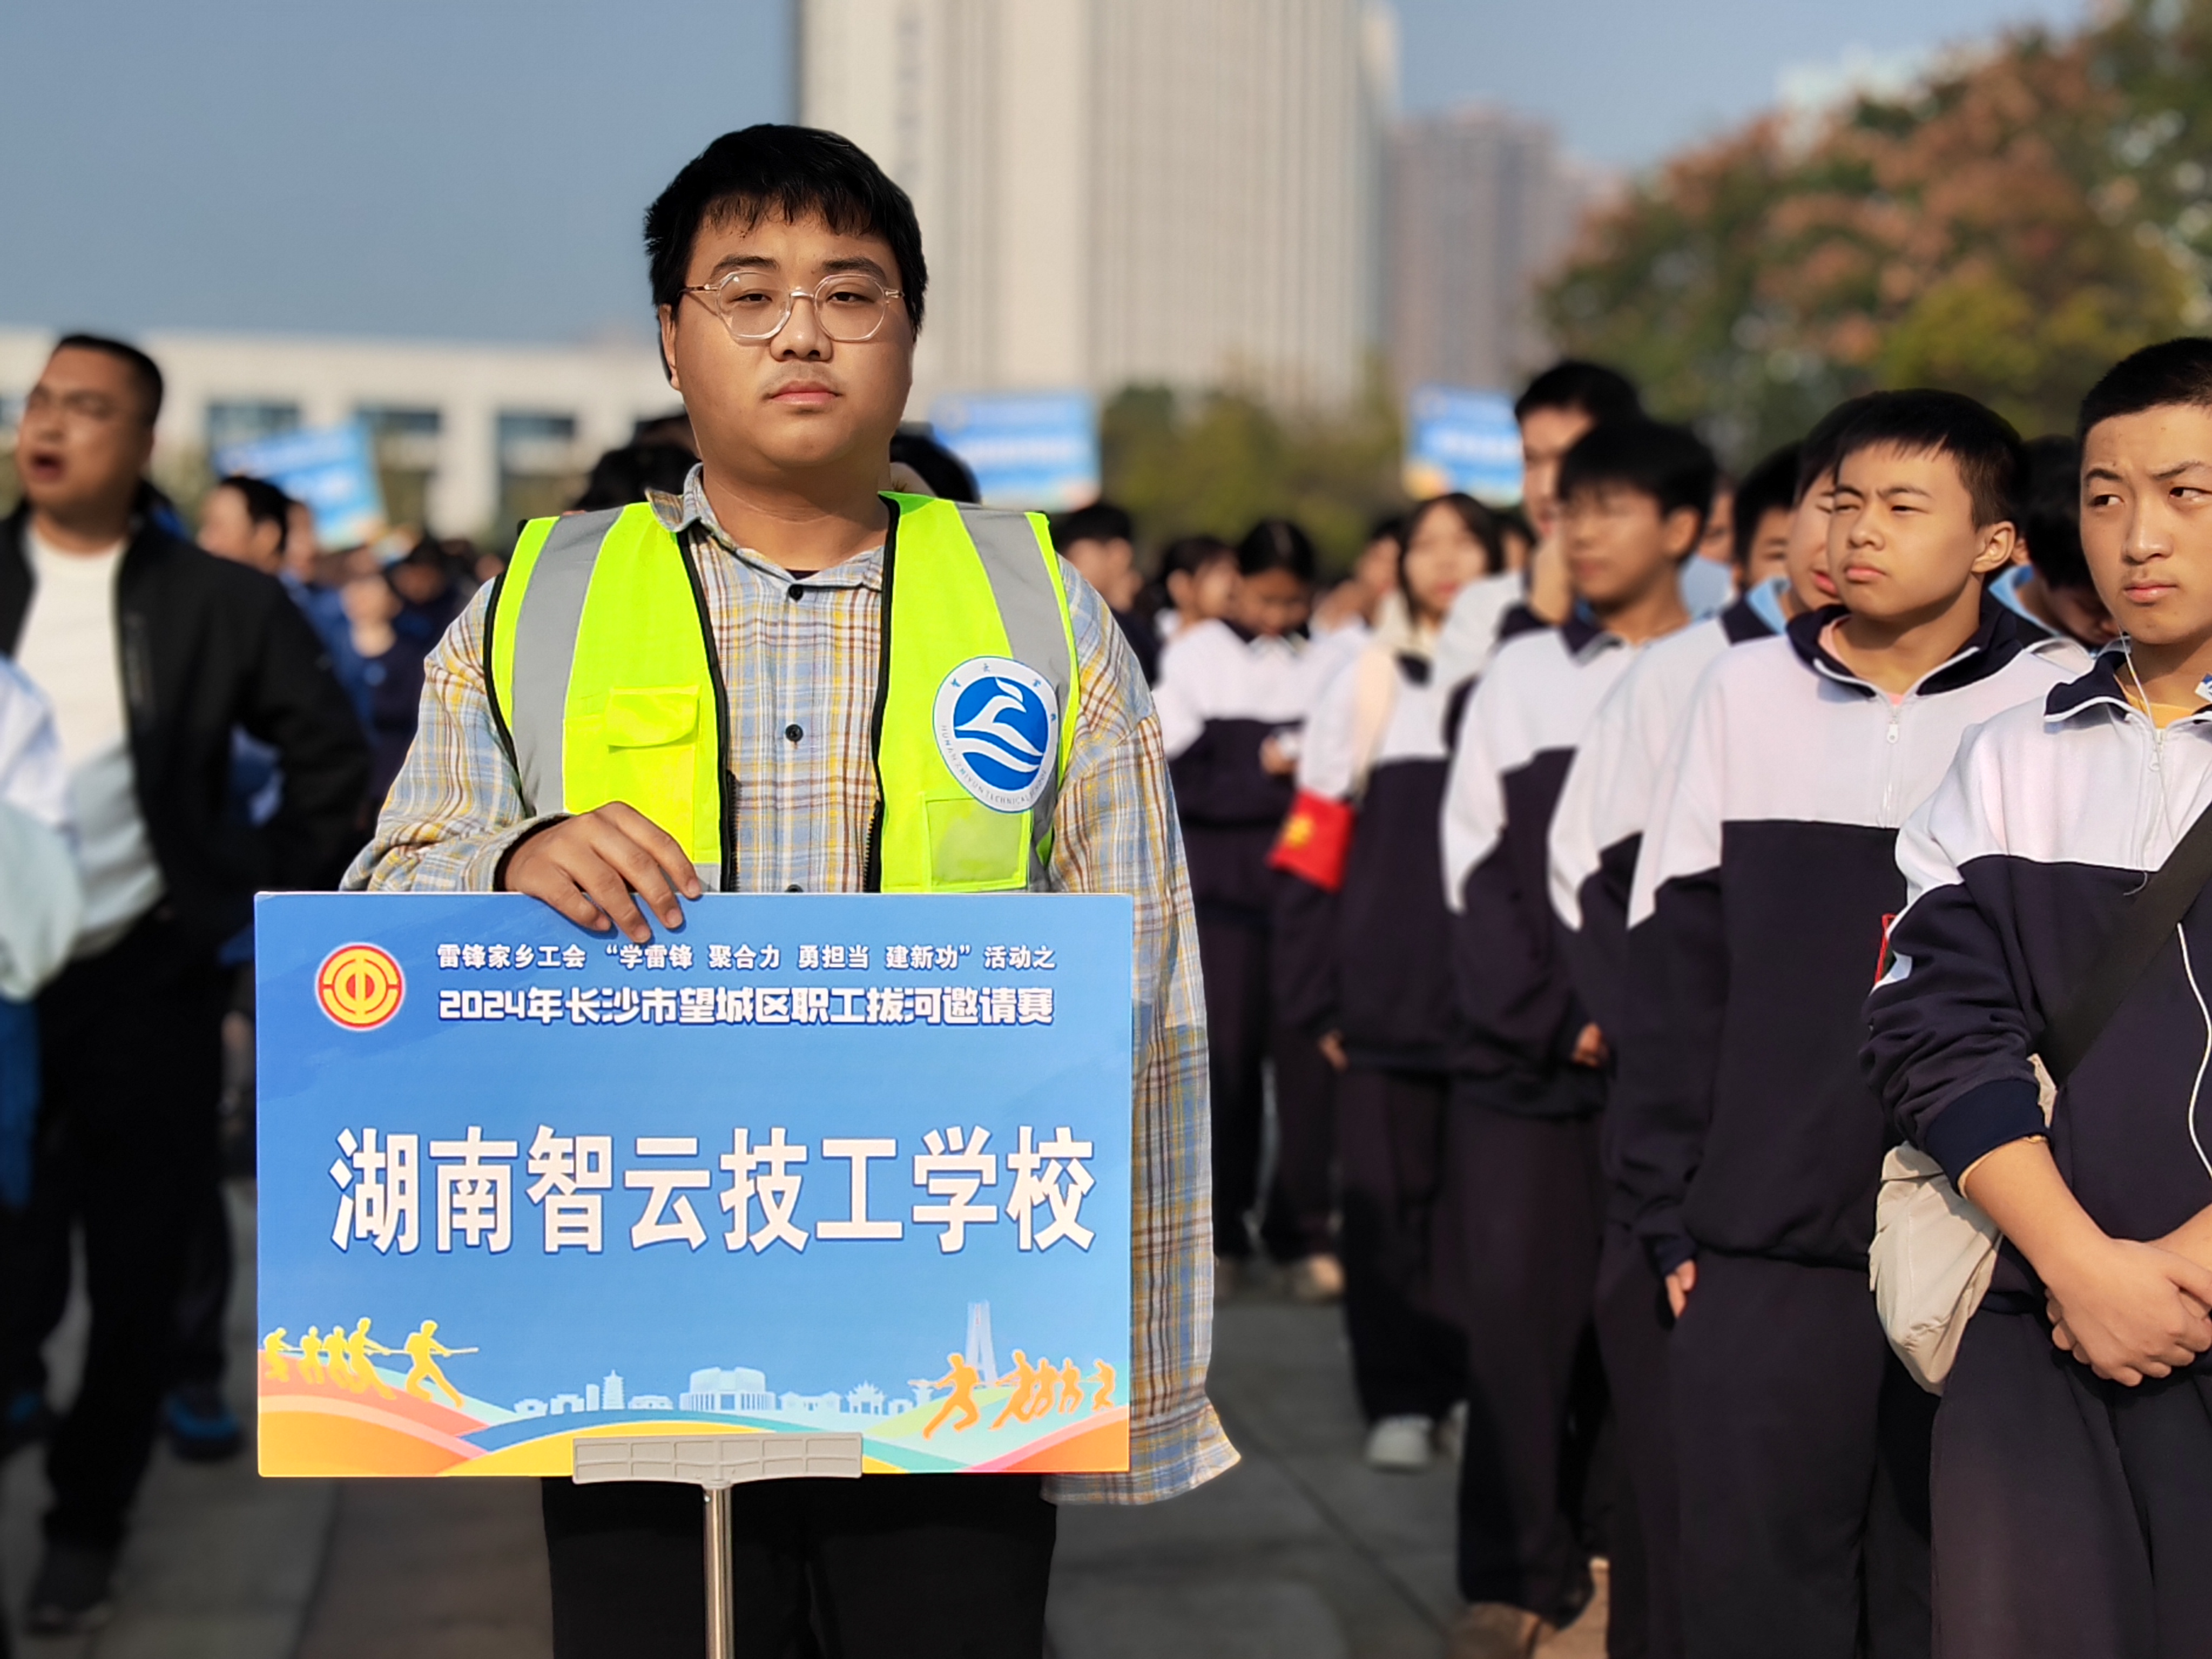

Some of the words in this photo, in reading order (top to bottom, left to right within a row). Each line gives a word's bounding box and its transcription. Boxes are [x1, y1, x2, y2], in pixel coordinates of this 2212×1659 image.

[437, 944, 585, 969] 雷锋家乡工会
[606, 944, 692, 969] “学雷锋
[709, 944, 779, 969] 聚合力
[798, 944, 868, 969] 勇担当
[886, 944, 970, 969] 建新功”
[984, 944, 1055, 970] 活动之
[439, 986, 1053, 1024] 2024年长沙市望城区职工拔河邀请赛
[330, 1125, 1095, 1252] 湖南智云技工学校
